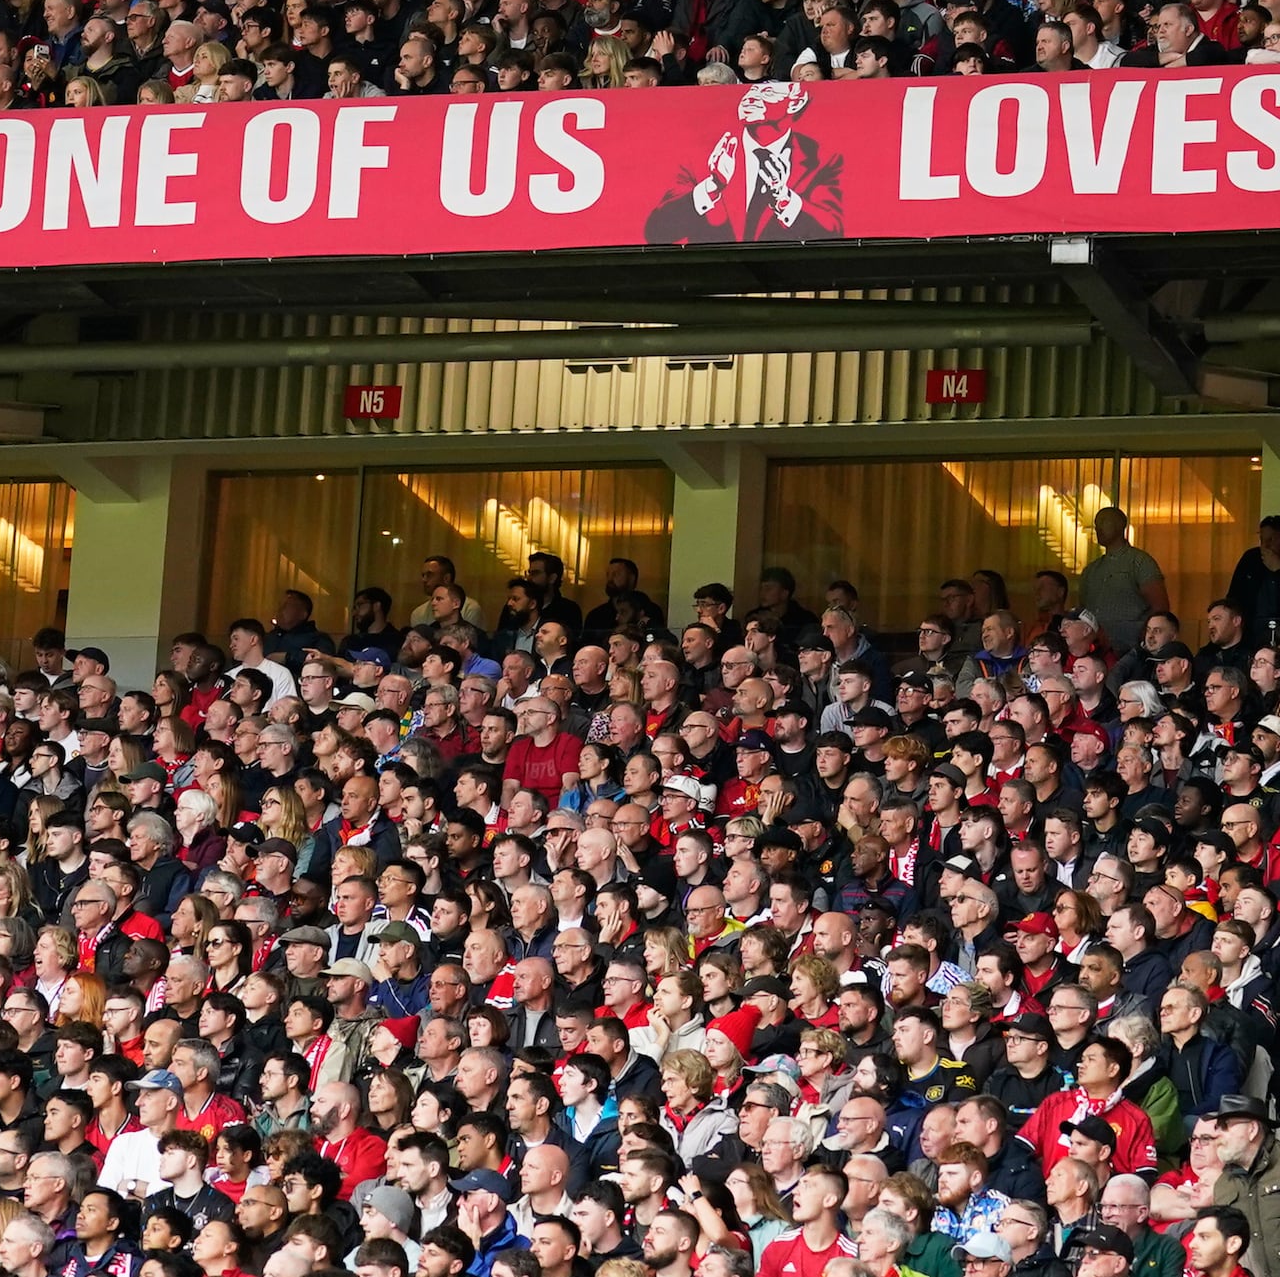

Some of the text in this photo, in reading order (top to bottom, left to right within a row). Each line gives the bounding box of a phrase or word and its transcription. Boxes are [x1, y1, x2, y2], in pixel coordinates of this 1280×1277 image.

[241, 106, 397, 223] OF
[440, 98, 605, 216] US
[942, 374, 969, 398] N4
[359, 390, 385, 413] N5
